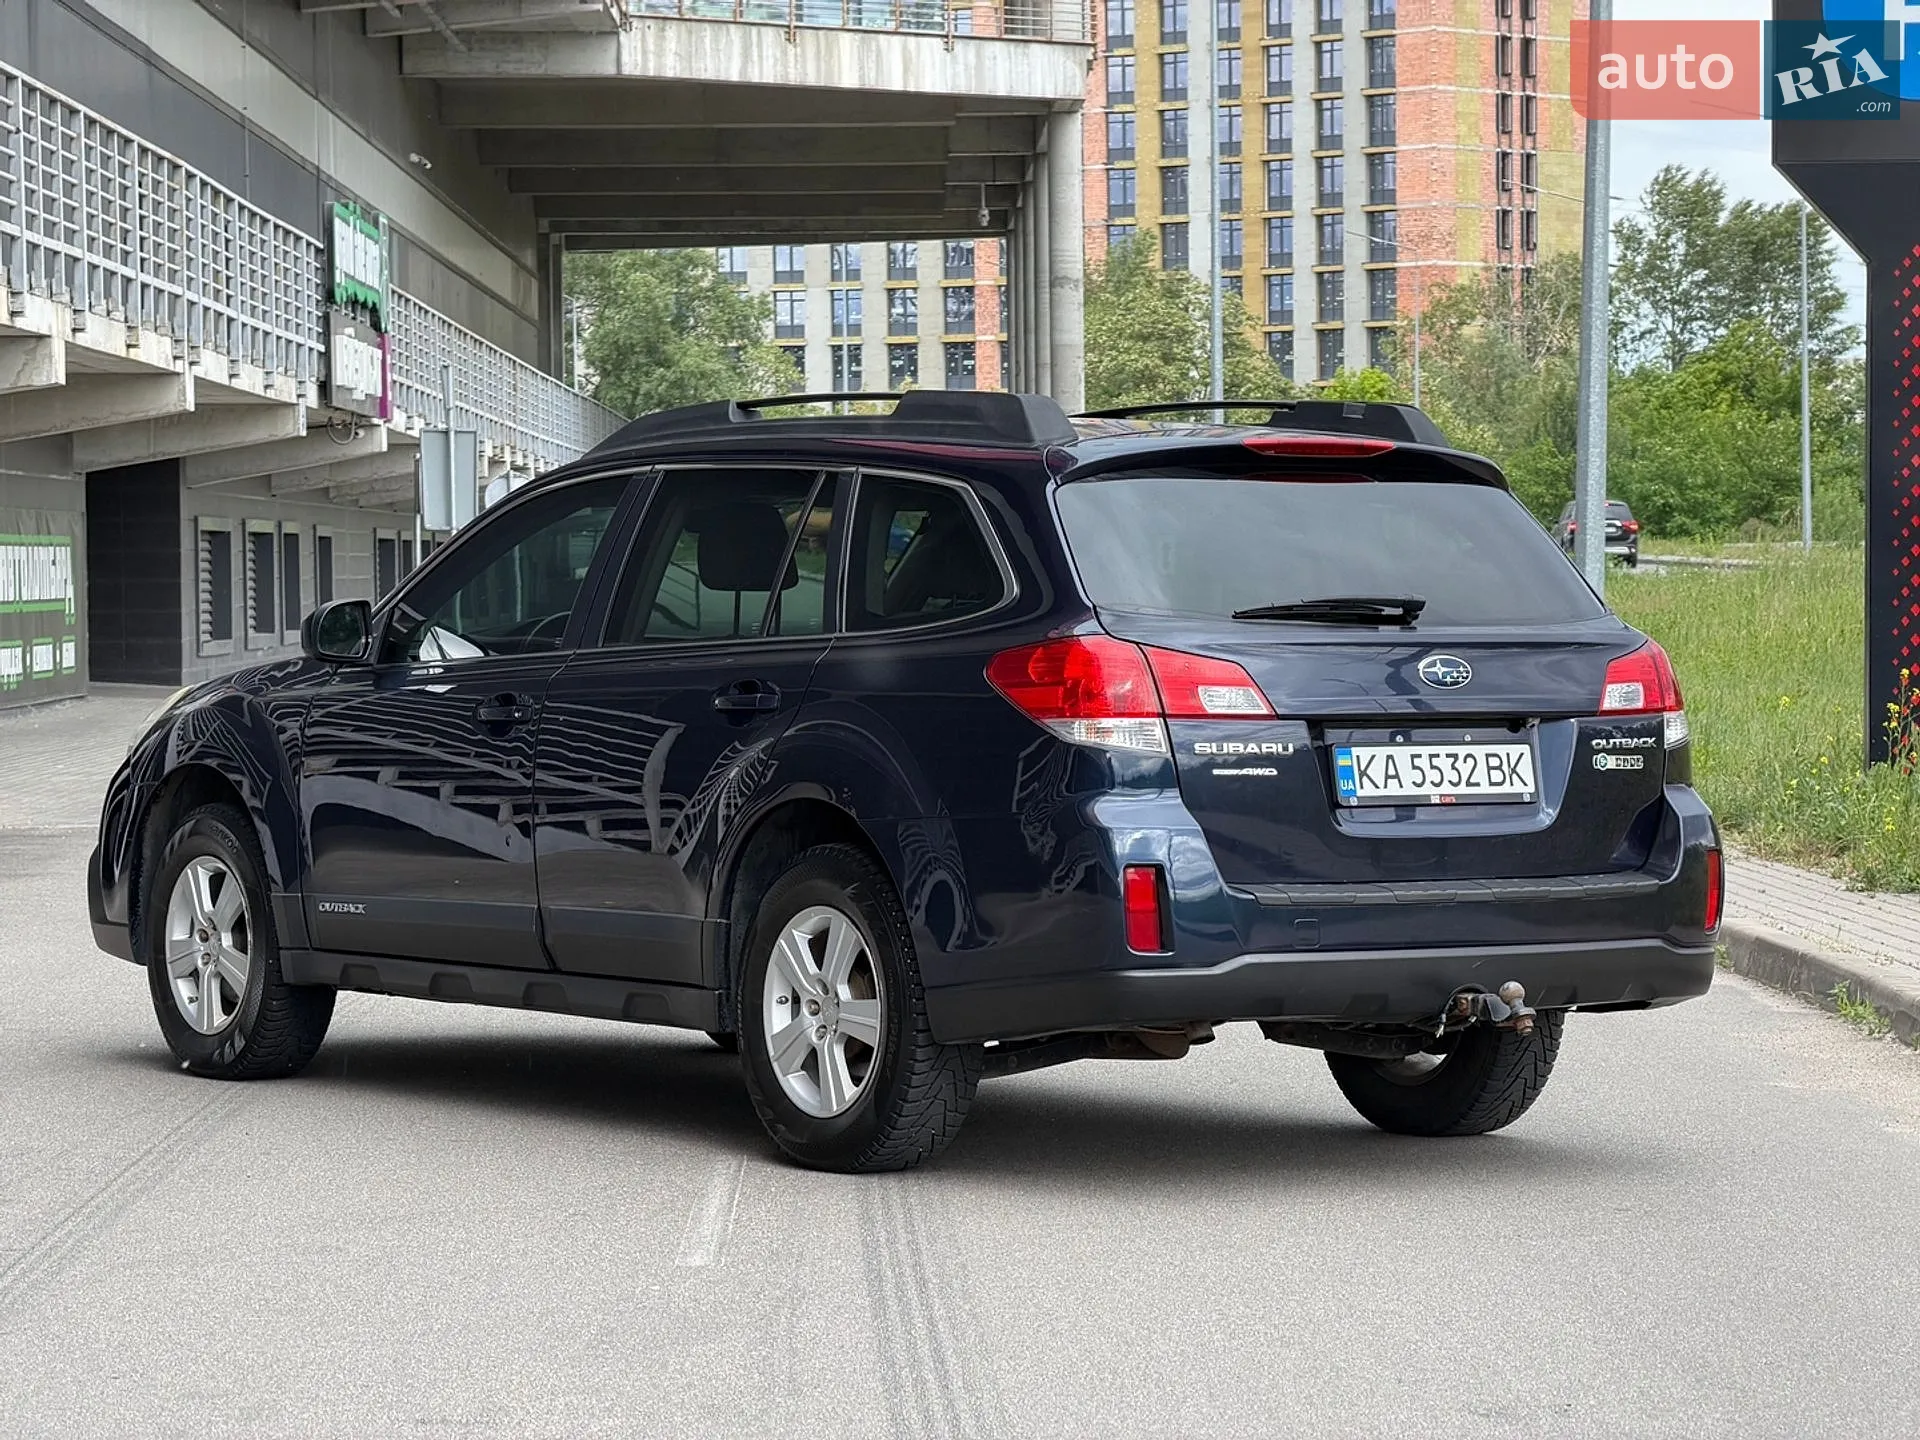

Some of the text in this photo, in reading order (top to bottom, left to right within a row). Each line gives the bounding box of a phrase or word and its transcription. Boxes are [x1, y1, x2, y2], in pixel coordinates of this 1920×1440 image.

[1591, 737, 1657, 749] OUTBACK
[1193, 742, 1295, 757] SUBARU
[1355, 752, 1529, 790] KA 5532 BK
[1341, 779, 1356, 791] UA
[318, 902, 368, 914] OUTBACK
